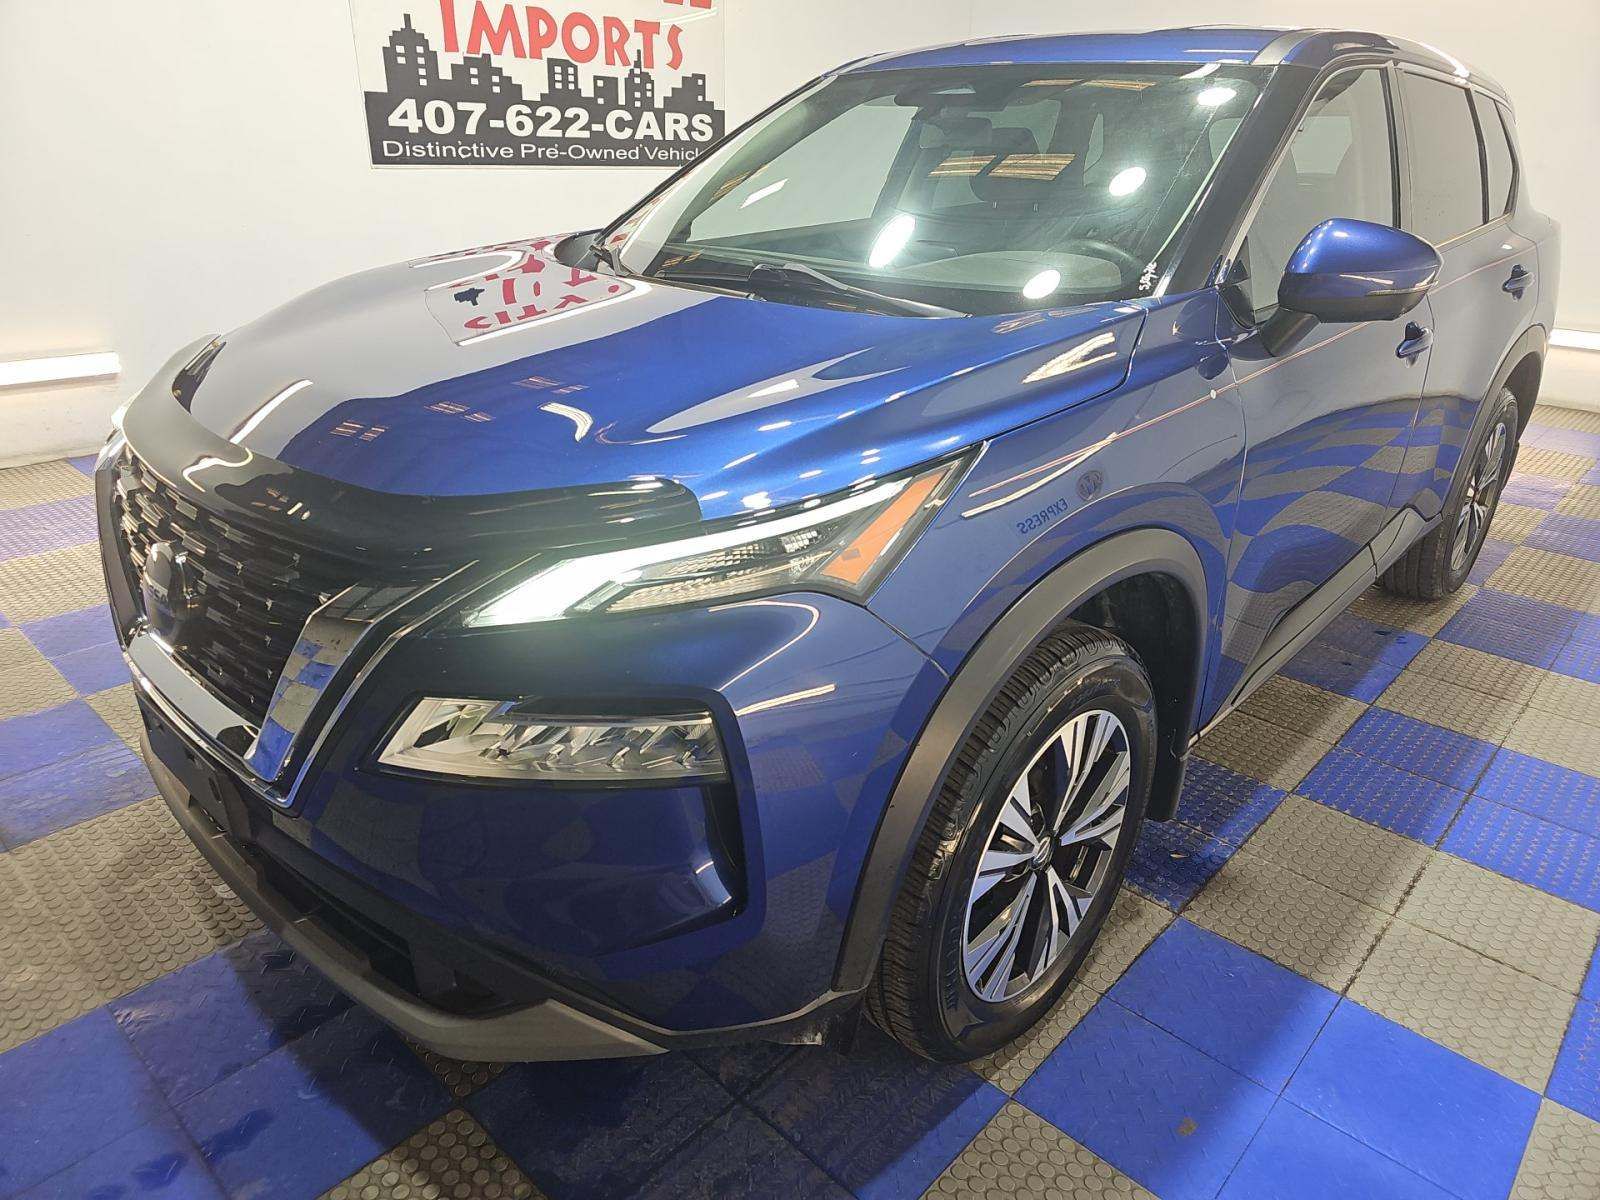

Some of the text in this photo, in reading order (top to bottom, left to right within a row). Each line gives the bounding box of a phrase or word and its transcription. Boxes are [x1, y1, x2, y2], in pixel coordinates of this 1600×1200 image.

[439, 0, 684, 71] IMPORTS
[387, 98, 714, 142] 407-622-CARS
[382, 140, 699, 161] Distinctive Pre-Owned Vehicl
